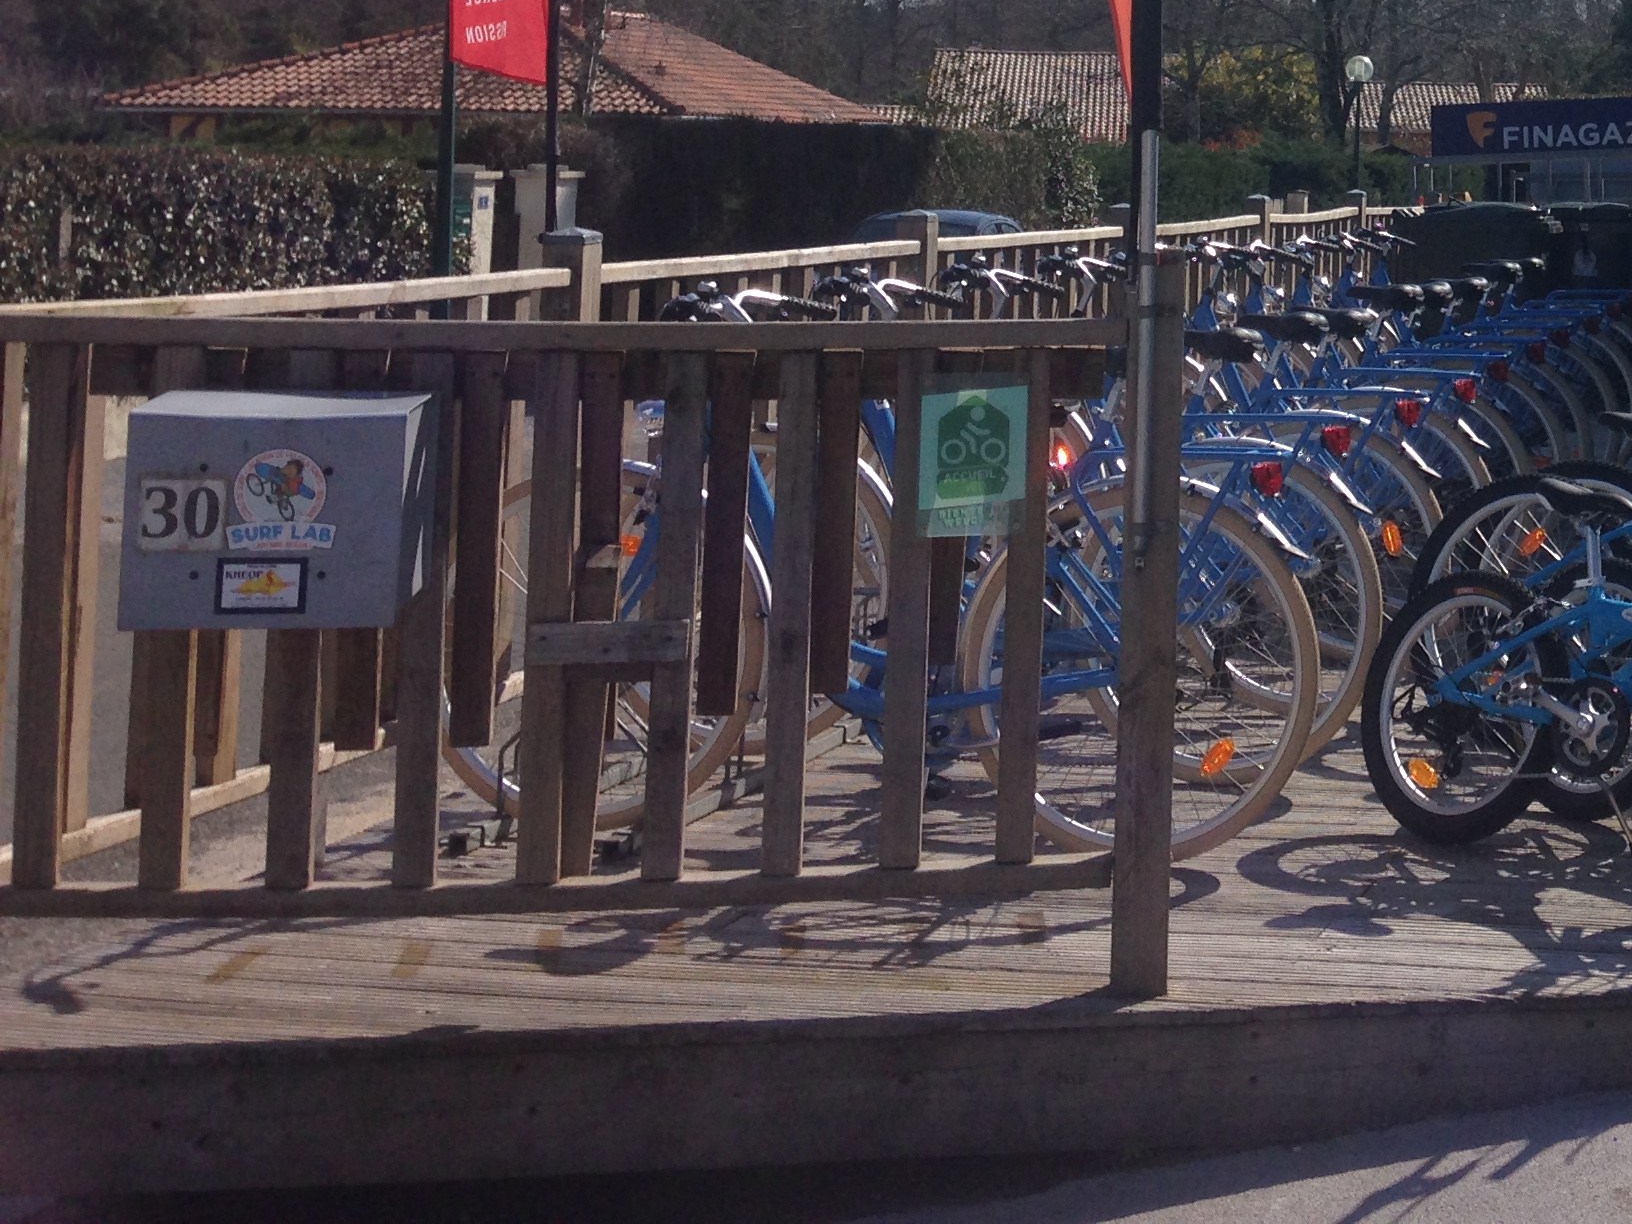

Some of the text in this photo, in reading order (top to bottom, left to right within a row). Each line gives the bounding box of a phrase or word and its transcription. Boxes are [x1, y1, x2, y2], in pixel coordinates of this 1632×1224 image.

[944, 467, 997, 483] ACCUEIL
[141, 485, 220, 539] 30
[231, 524, 331, 544] SURF LAB
